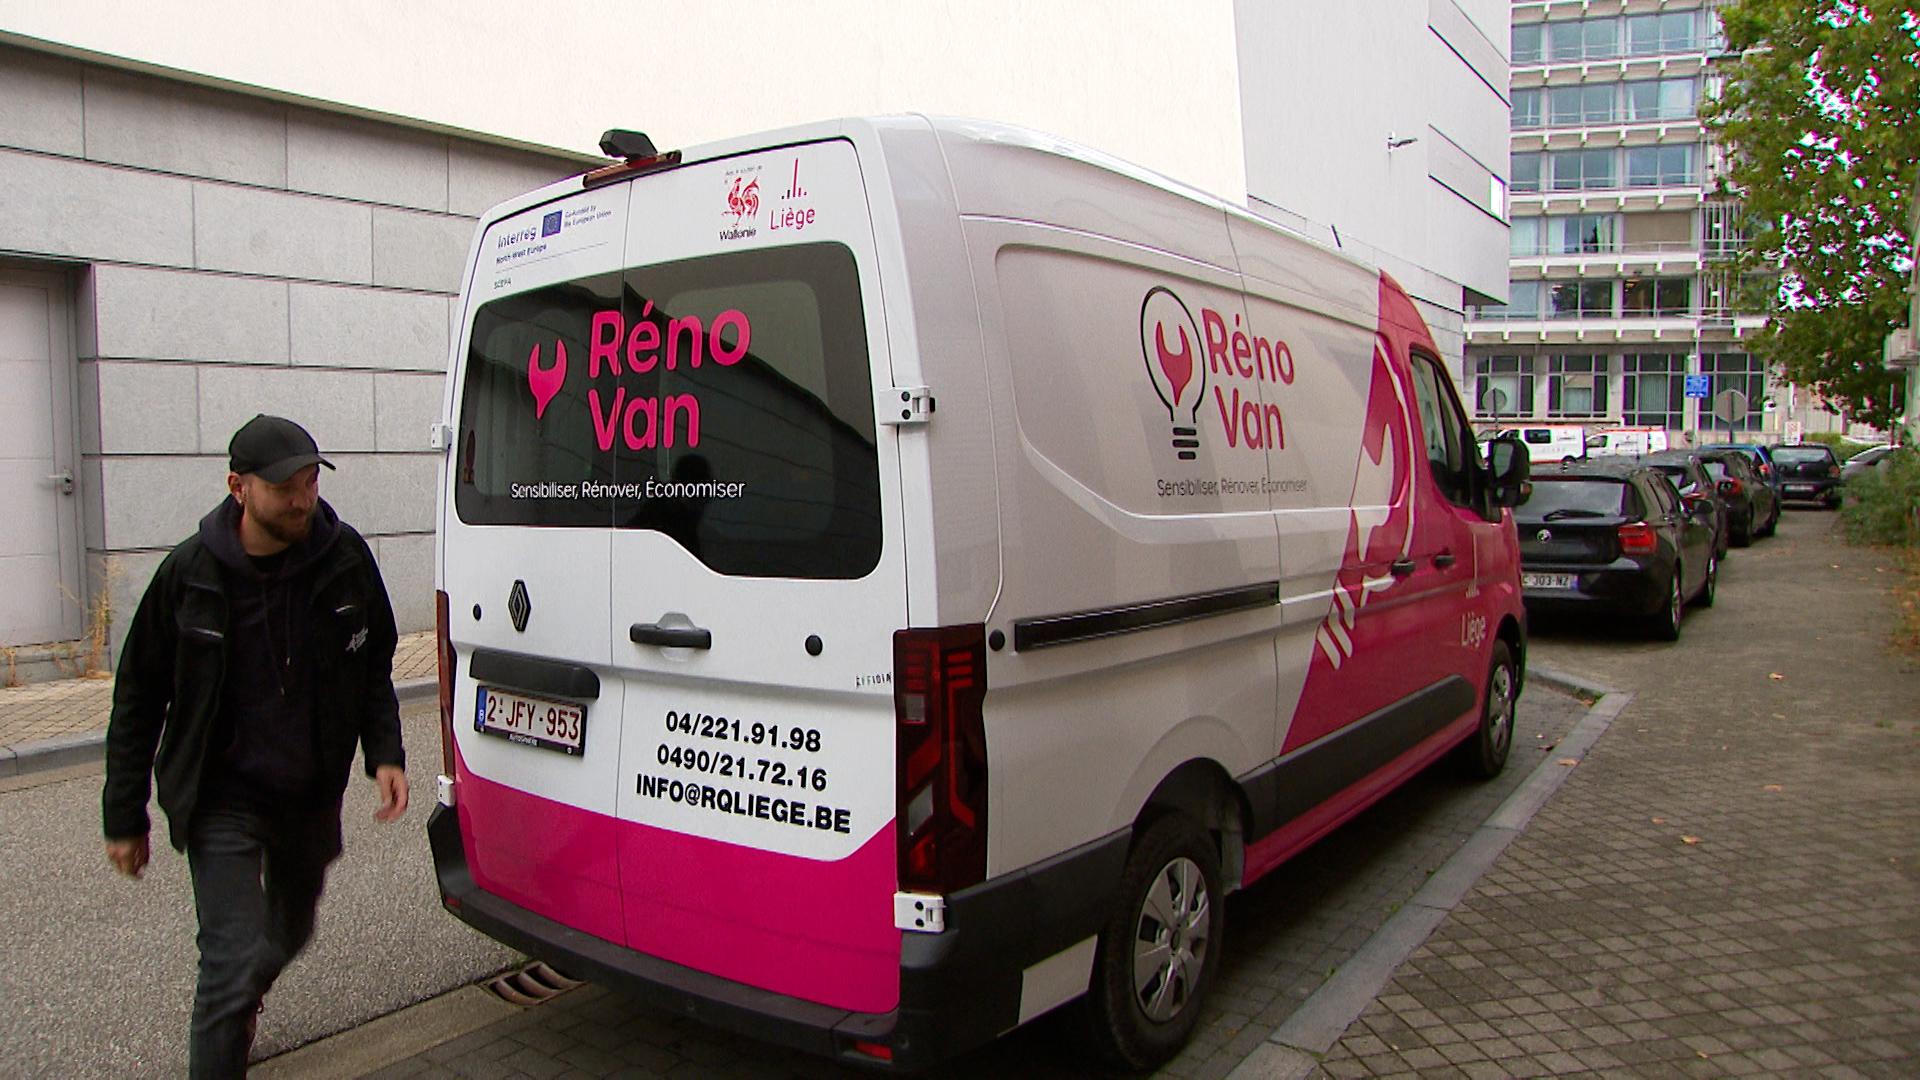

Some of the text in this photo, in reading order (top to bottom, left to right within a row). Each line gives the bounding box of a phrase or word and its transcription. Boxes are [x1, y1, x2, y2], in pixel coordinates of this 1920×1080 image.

[498, 227, 537, 249] Interreg
[719, 227, 757, 240] Wallonie
[770, 207, 815, 230] Liège
[588, 300, 752, 378] Réno
[1202, 308, 1294, 385] Réno
[588, 387, 701, 452] Van
[1215, 385, 1285, 450] Van
[511, 475, 745, 499] Sensibiliser, Rénover, Économiser
[1157, 479, 1219, 497] Sensibiliser,
[1461, 612, 1486, 648] Liège
[666, 711, 821, 752] 04/221.91.98
[656, 745, 827, 791] 0490/21.72.16
[636, 774, 851, 833] INFO@RQLIEGE.BE
